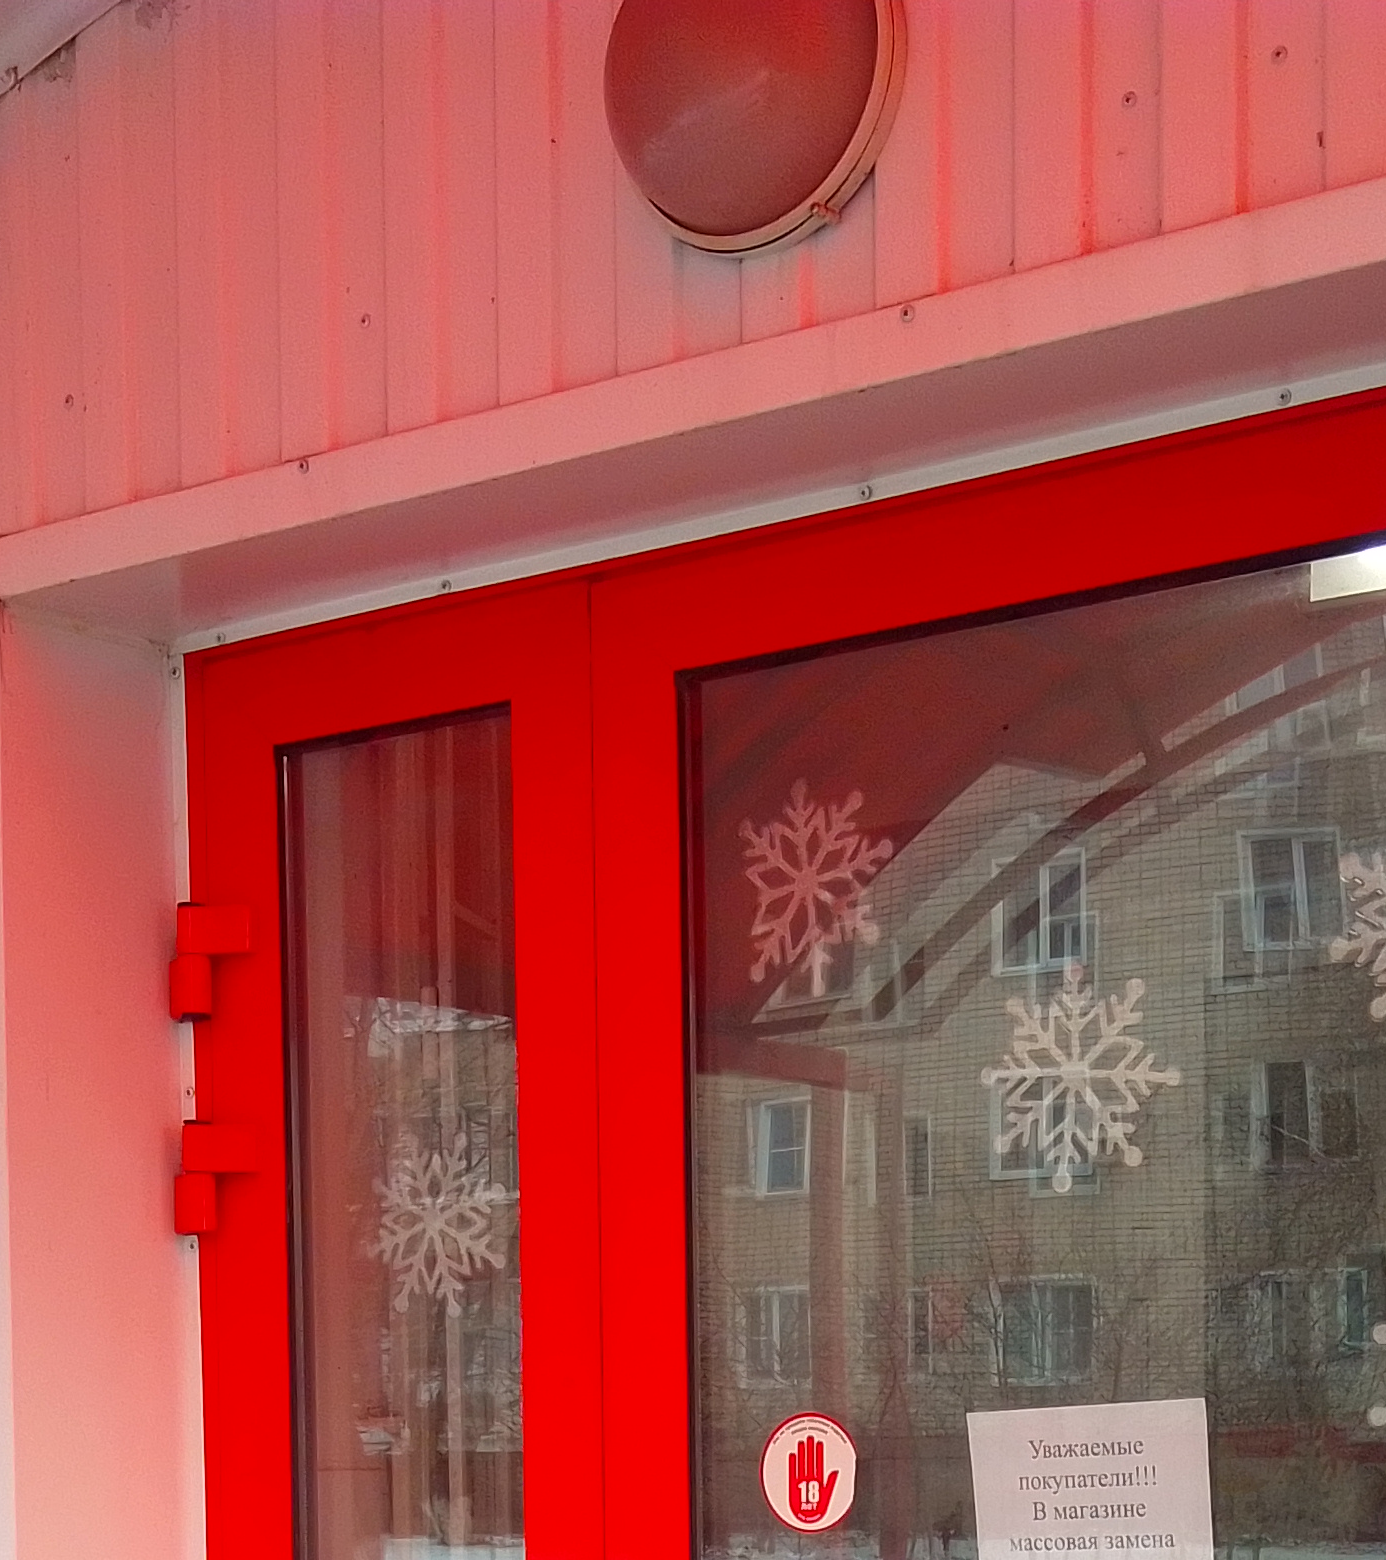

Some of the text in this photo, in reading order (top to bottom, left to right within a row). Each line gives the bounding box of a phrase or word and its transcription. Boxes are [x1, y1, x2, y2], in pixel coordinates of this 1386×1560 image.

[1028, 1439, 1144, 1459] Уважаемые
[1018, 1465, 1157, 1495] покупатели!!!
[797, 1480, 820, 1503] 18
[1033, 1501, 1147, 1521] В магазине
[1010, 1533, 1175, 1551] массовая замена
